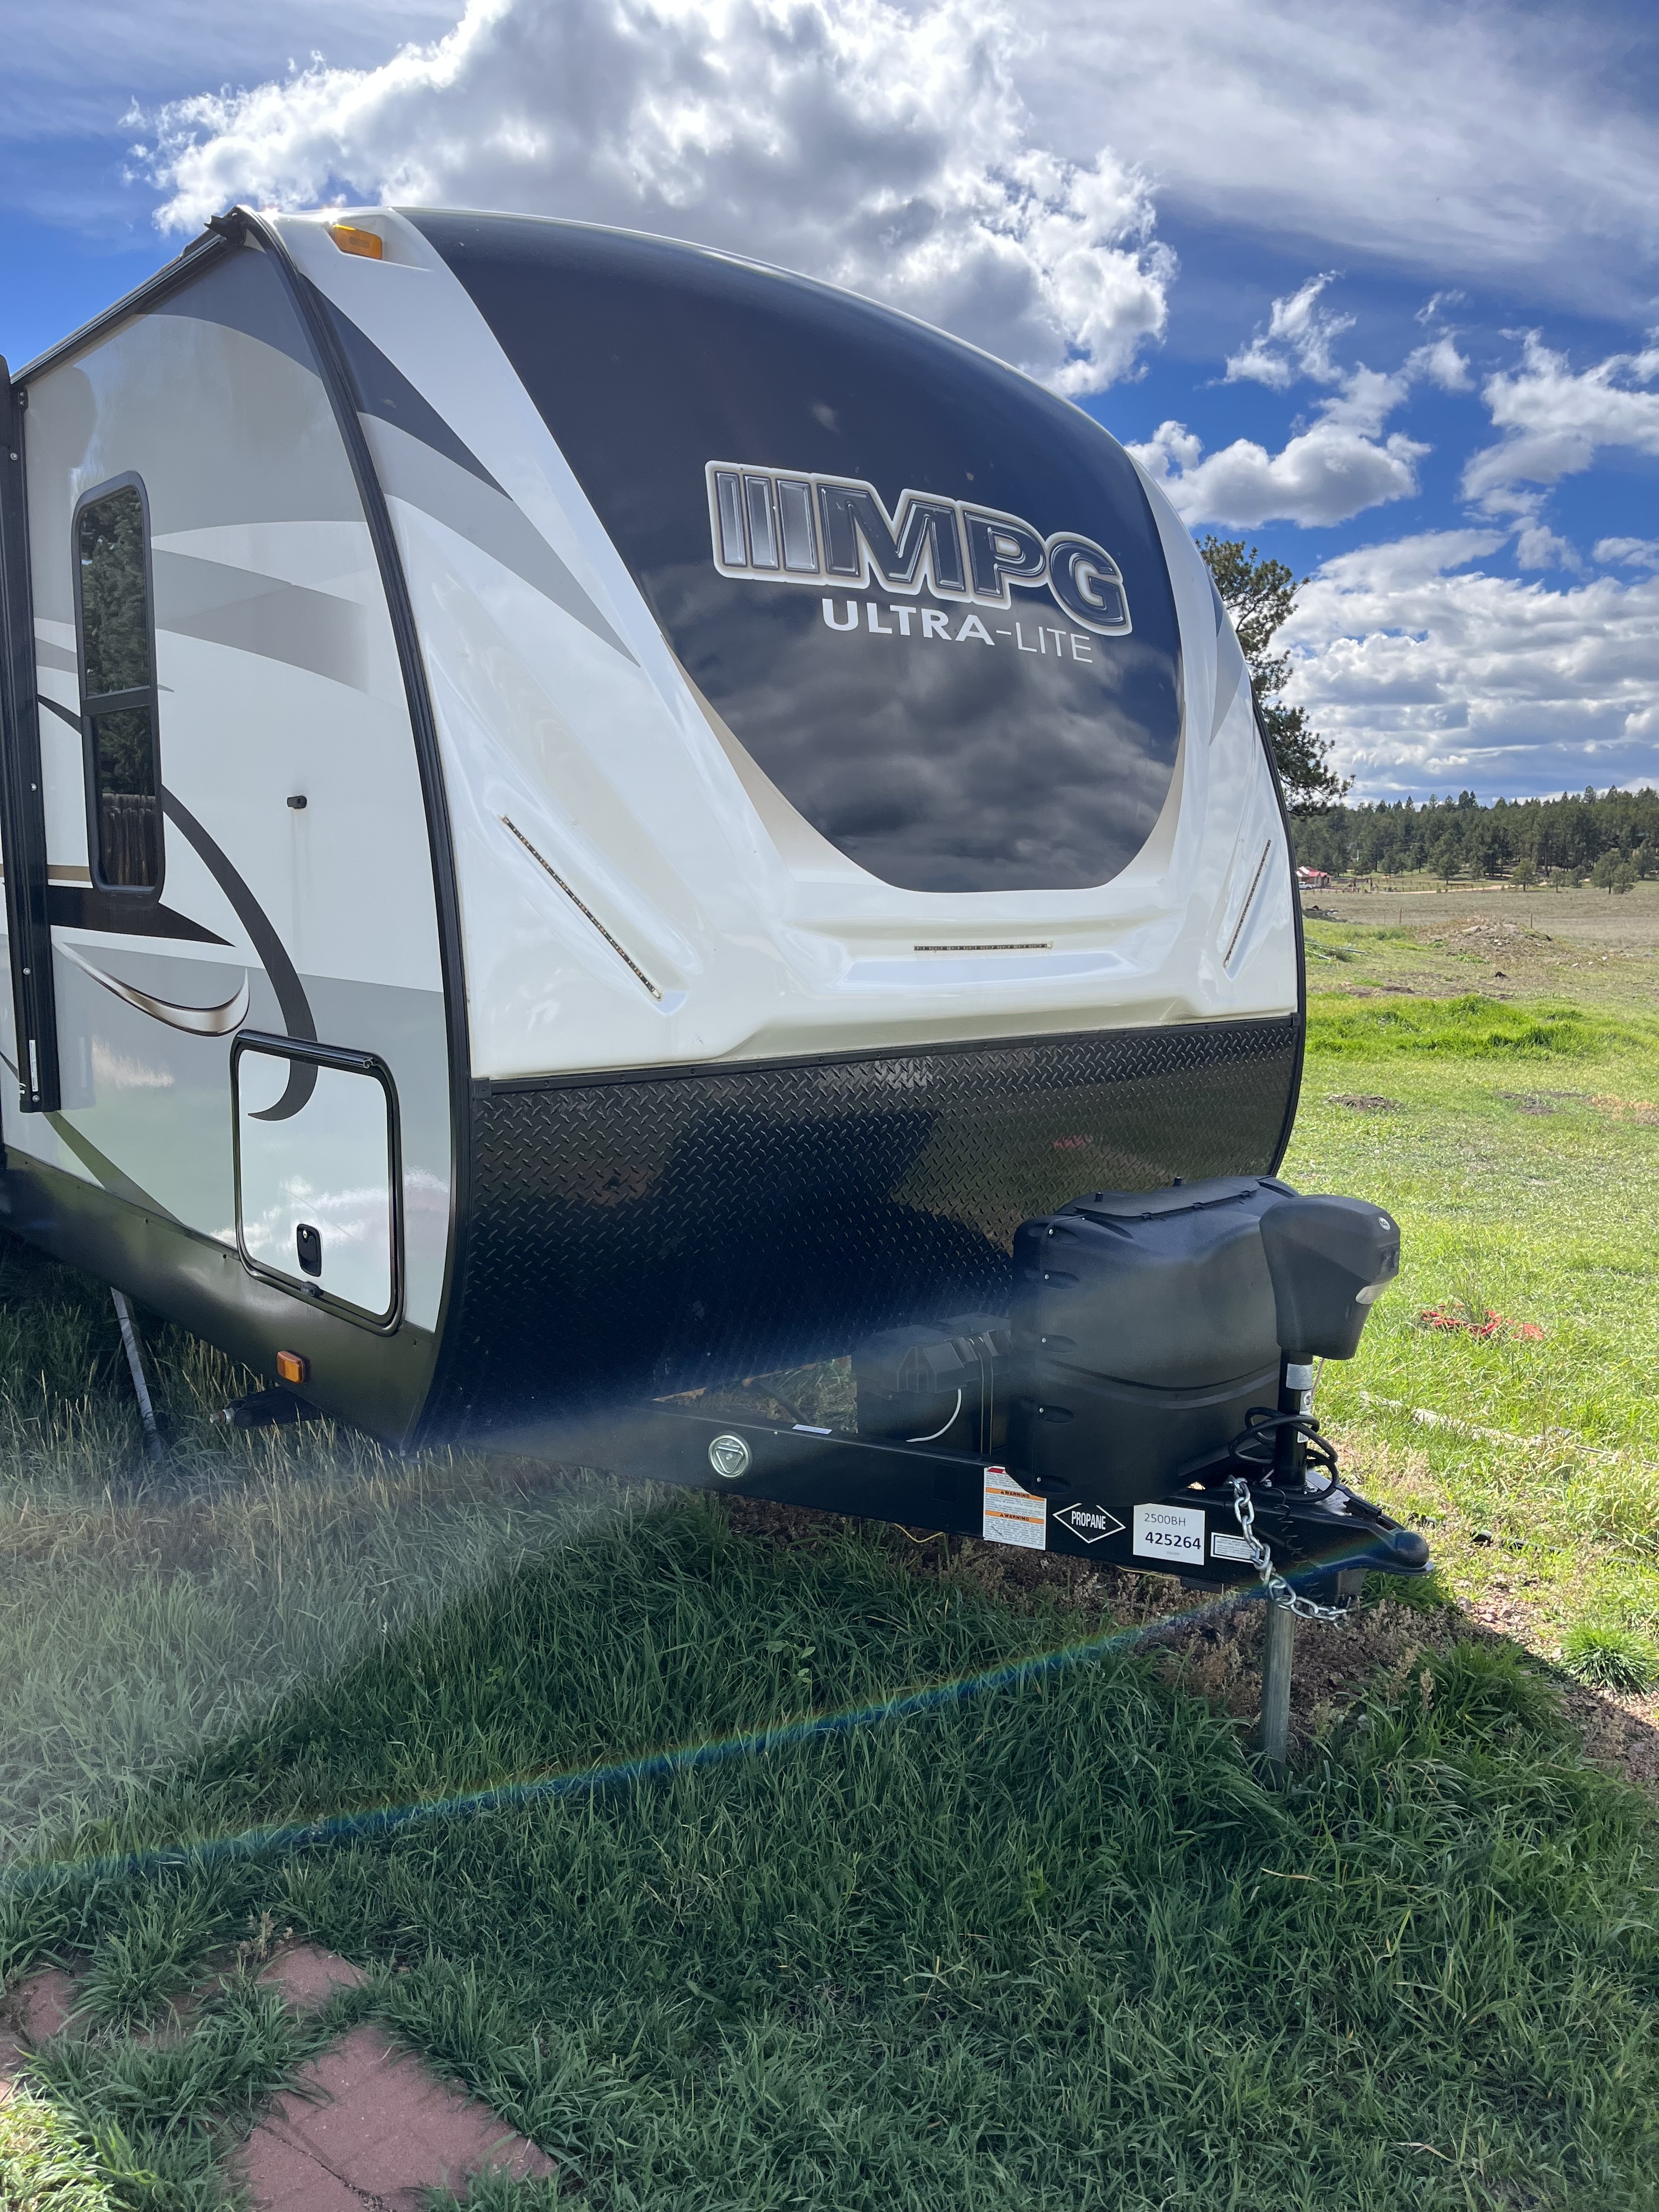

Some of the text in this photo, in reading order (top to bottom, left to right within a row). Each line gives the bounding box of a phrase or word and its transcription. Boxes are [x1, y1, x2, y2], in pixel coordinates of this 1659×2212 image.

[816, 475, 1132, 636] MPG
[821, 597, 1093, 664] ULTRA-LITE
[1071, 1510, 1107, 1531] PROPANE
[1144, 1513, 1186, 1527] 2500BH
[1144, 1531, 1201, 1550] 425264
